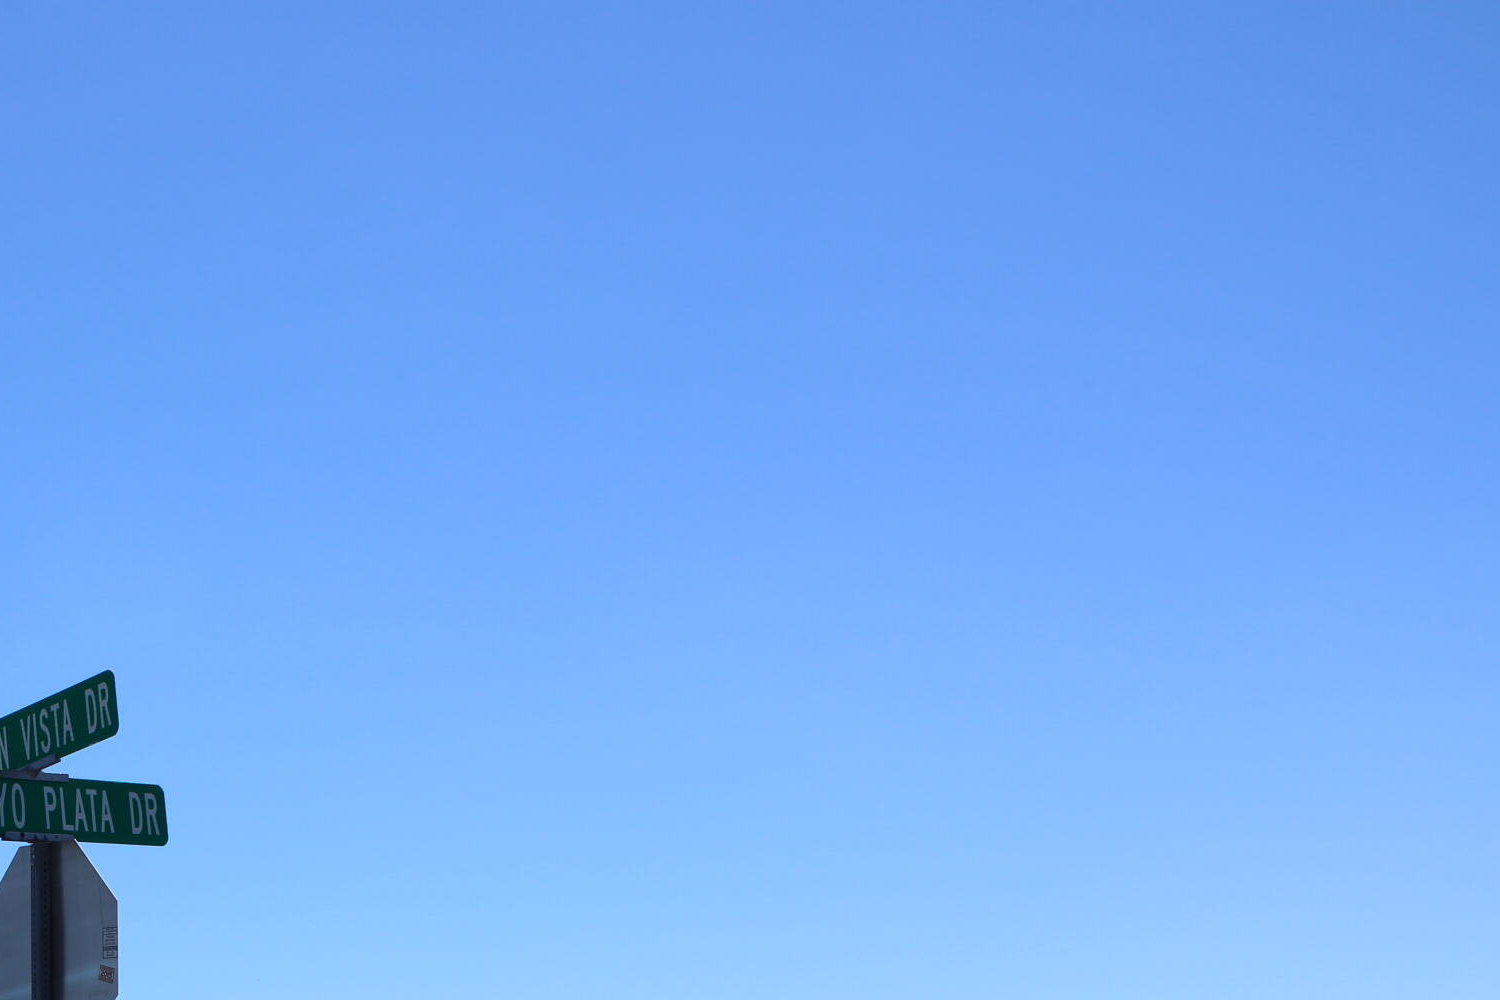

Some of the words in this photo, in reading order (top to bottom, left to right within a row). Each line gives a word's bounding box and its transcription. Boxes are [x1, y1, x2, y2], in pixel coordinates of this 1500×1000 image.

[19, 699, 75, 760] VISTA
[85, 681, 112, 734] DR
[43, 786, 115, 833] PLATA
[129, 791, 160, 836] DR
